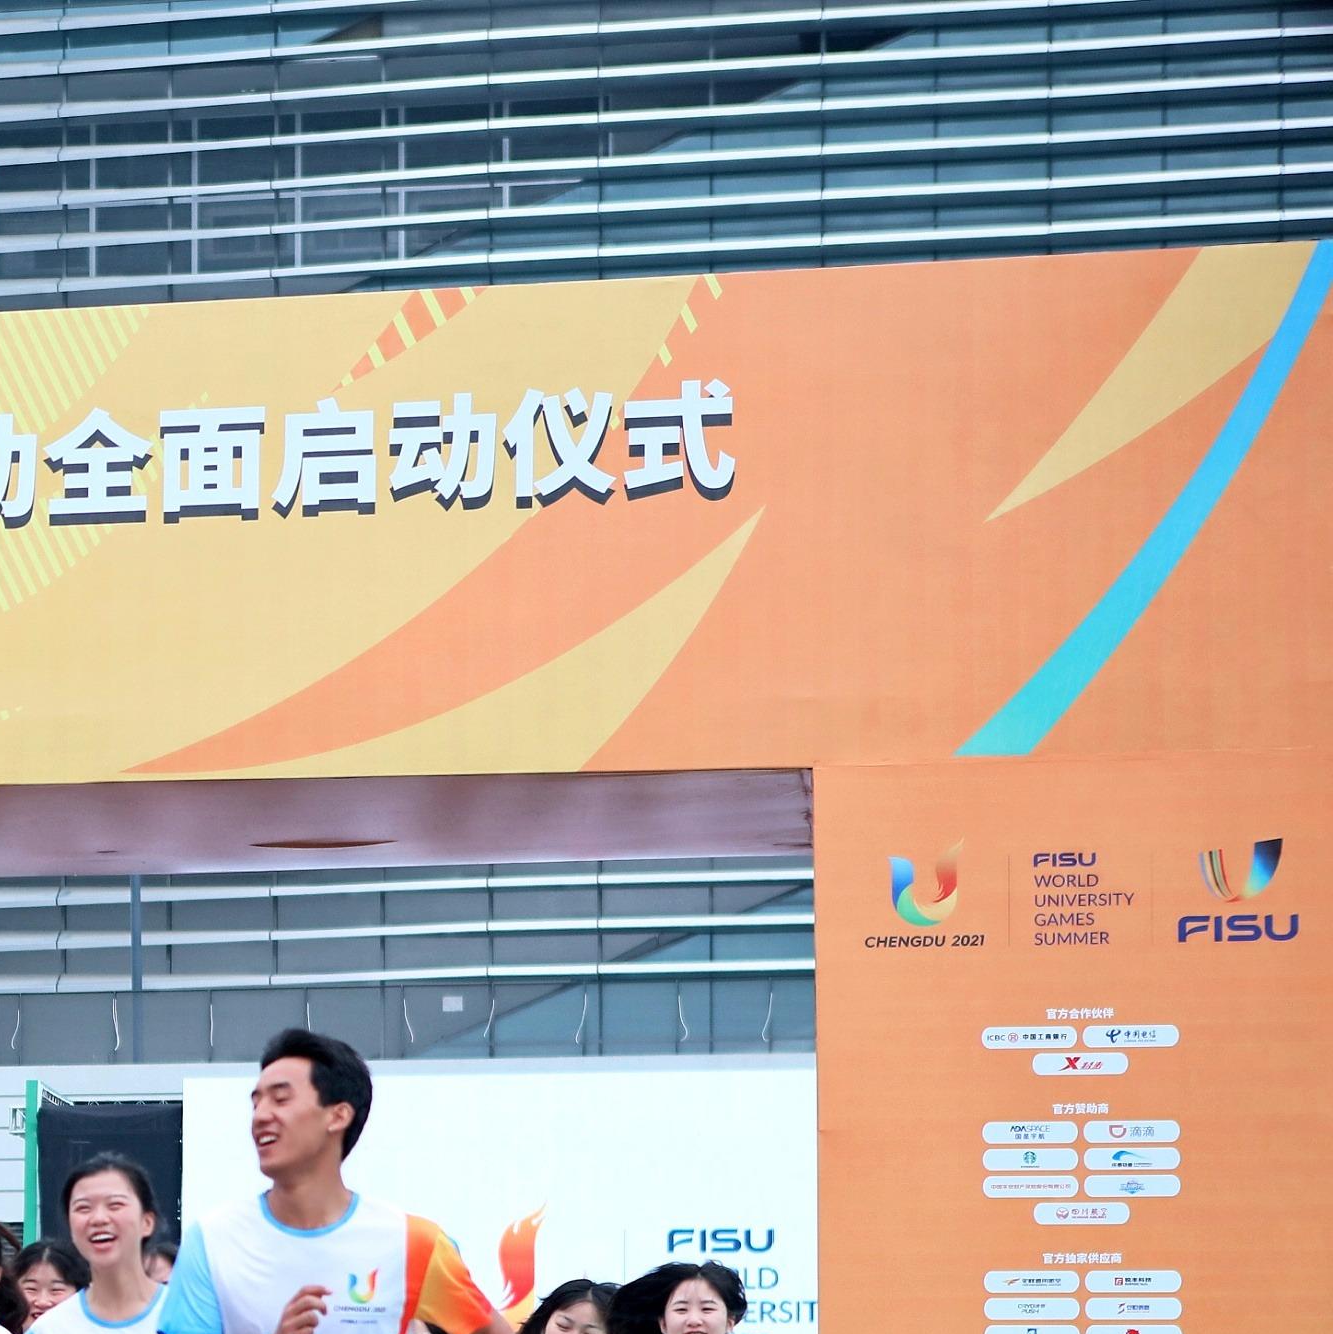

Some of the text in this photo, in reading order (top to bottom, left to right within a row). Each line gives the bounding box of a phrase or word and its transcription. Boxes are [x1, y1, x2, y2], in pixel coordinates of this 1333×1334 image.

[1033, 852, 1096, 868] FISU
[1034, 873, 1099, 888] WORLD
[1034, 892, 1135, 908] UNIVERSITY
[1034, 912, 1095, 927] GAMES
[1177, 913, 1300, 943] FISU
[864, 934, 986, 949] CHENGDU 2021
[1034, 931, 1110, 946] SUMMER
[1045, 1007, 1115, 1020] 官方合作伙伴
[1052, 1103, 1110, 1115] 官方赞助商
[667, 1228, 775, 1253] FISU
[1042, 1252, 1123, 1265] 官方独家供应商
[744, 1267, 779, 1290] LD
[743, 1300, 818, 1323] ERSIT
